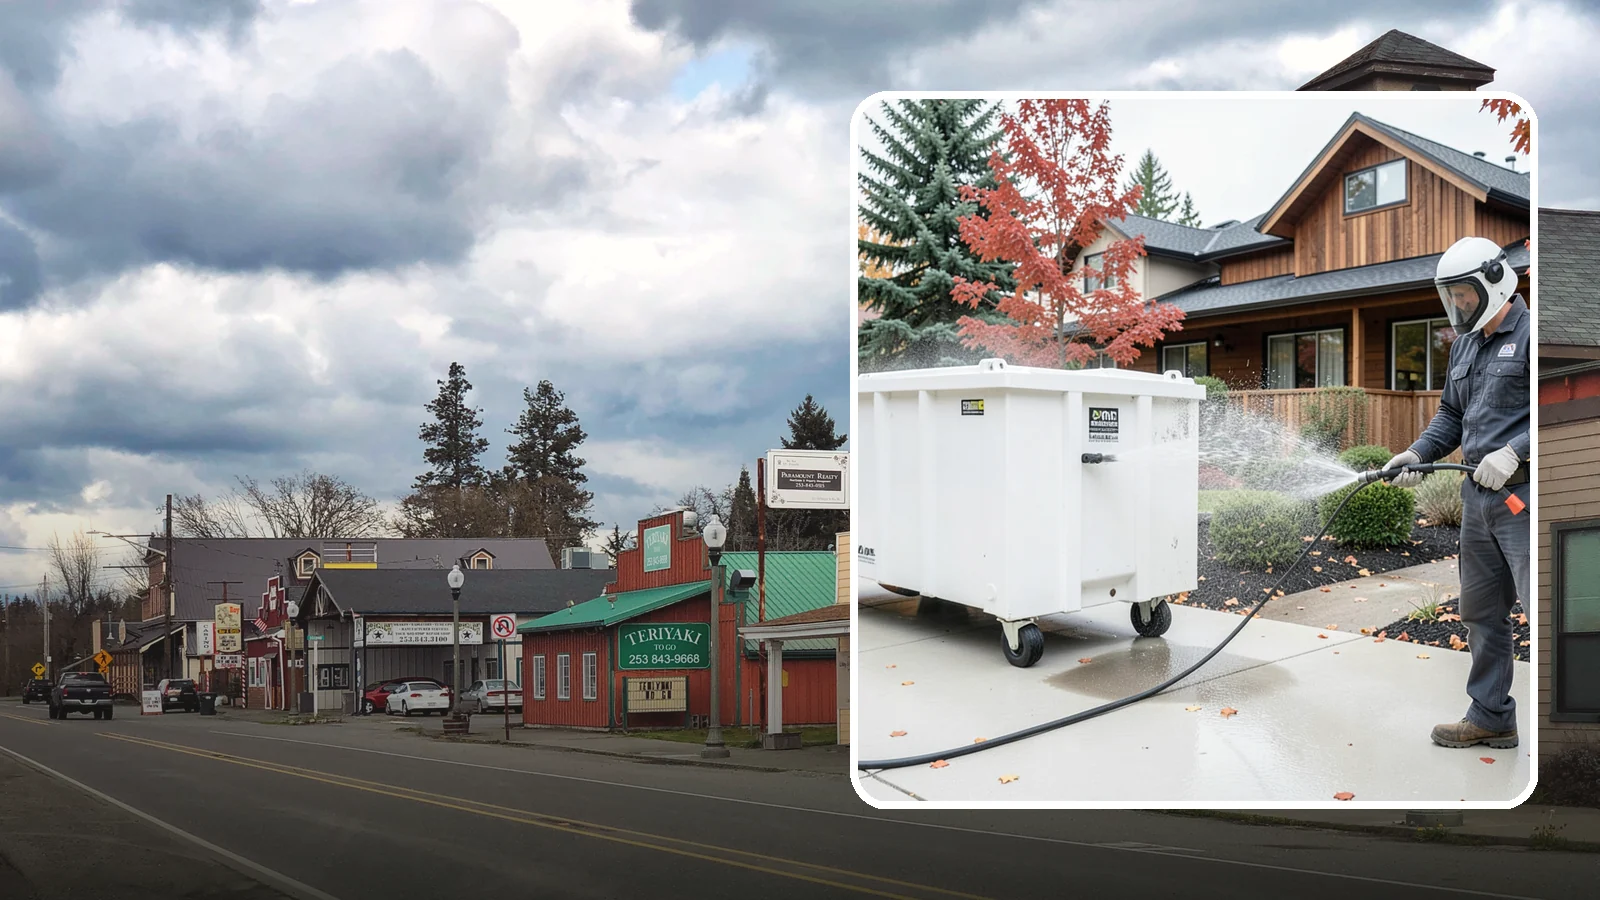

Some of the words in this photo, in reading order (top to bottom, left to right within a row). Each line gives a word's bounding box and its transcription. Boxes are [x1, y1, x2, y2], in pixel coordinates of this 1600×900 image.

[624, 628, 702, 646] TERIYAKI
[628, 654, 648, 664] 253
[652, 654, 700, 664] 843-9668
[640, 681, 672, 691] TERIYAKI
